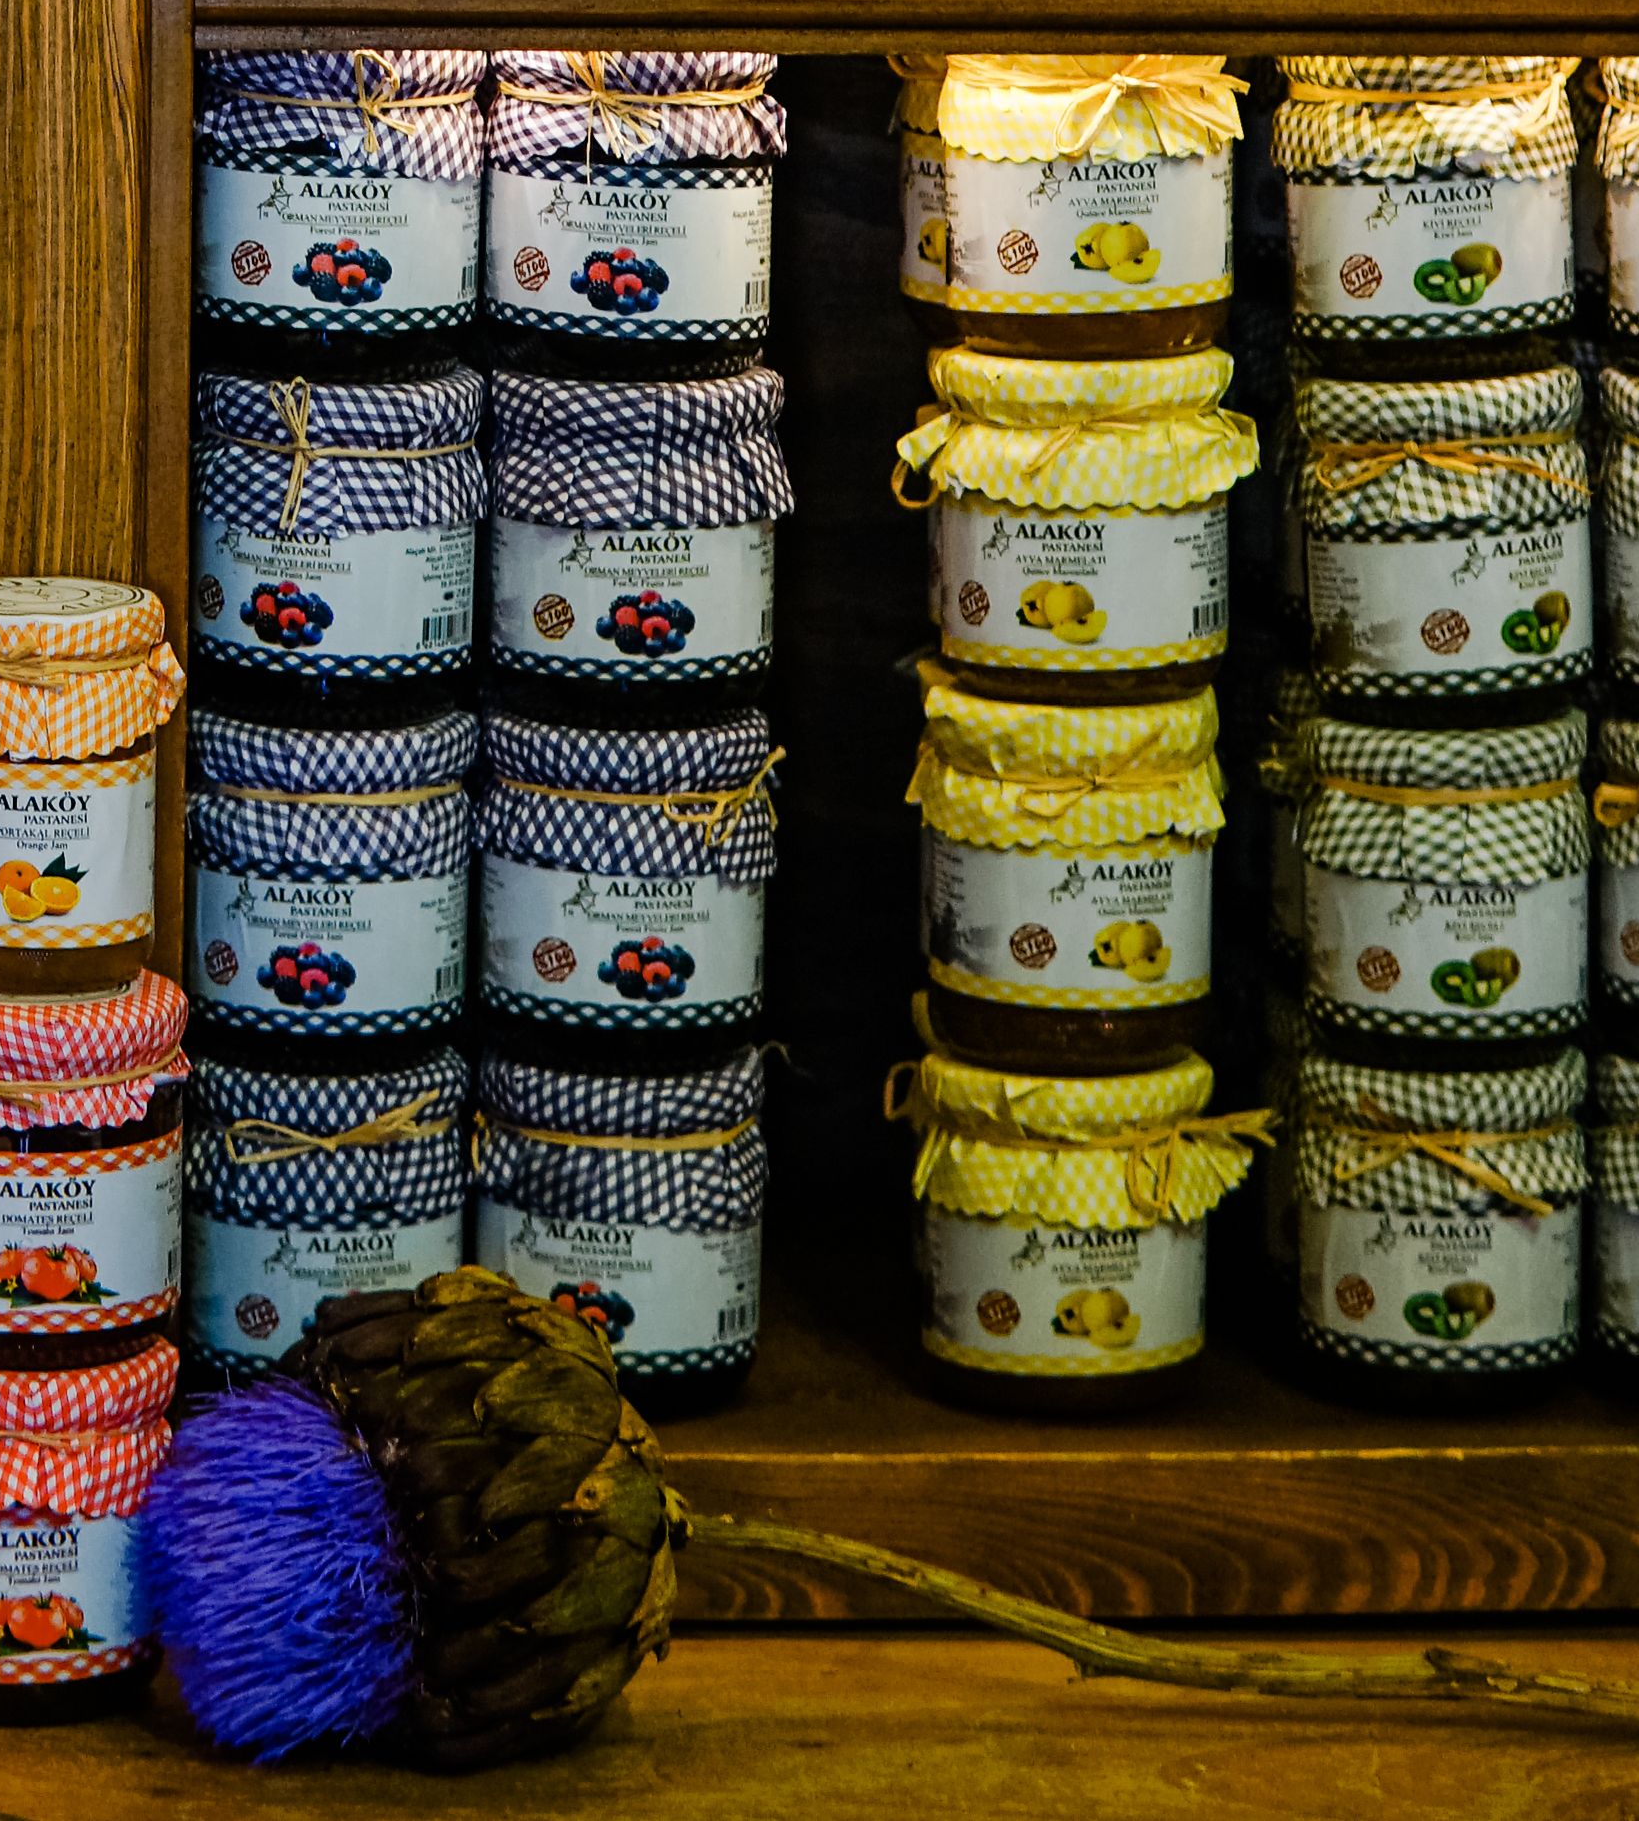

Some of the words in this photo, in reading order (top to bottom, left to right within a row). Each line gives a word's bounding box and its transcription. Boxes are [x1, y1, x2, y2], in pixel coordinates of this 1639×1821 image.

[299, 180, 392, 199] ALAKÖY
[328, 200, 389, 212] PASTANESİ
[579, 189, 670, 210] ALAKÖY
[605, 210, 668, 222] PASTANESİ
[1015, 520, 1105, 540] ALAKÖY
[601, 531, 693, 551] ALAKÖY
[1041, 541, 1103, 552] PASTANESİ
[24, 813, 88, 825] PASTANESİ
[52, 825, 89, 838] REÇELİ
[16, 840, 48, 851] Orange
[51, 840, 68, 850] Jam
[263, 886, 354, 905] ALAKÖY
[0, 1177, 95, 1199] ALAKÖY
[29, 1199, 92, 1211] PASTANESİ
